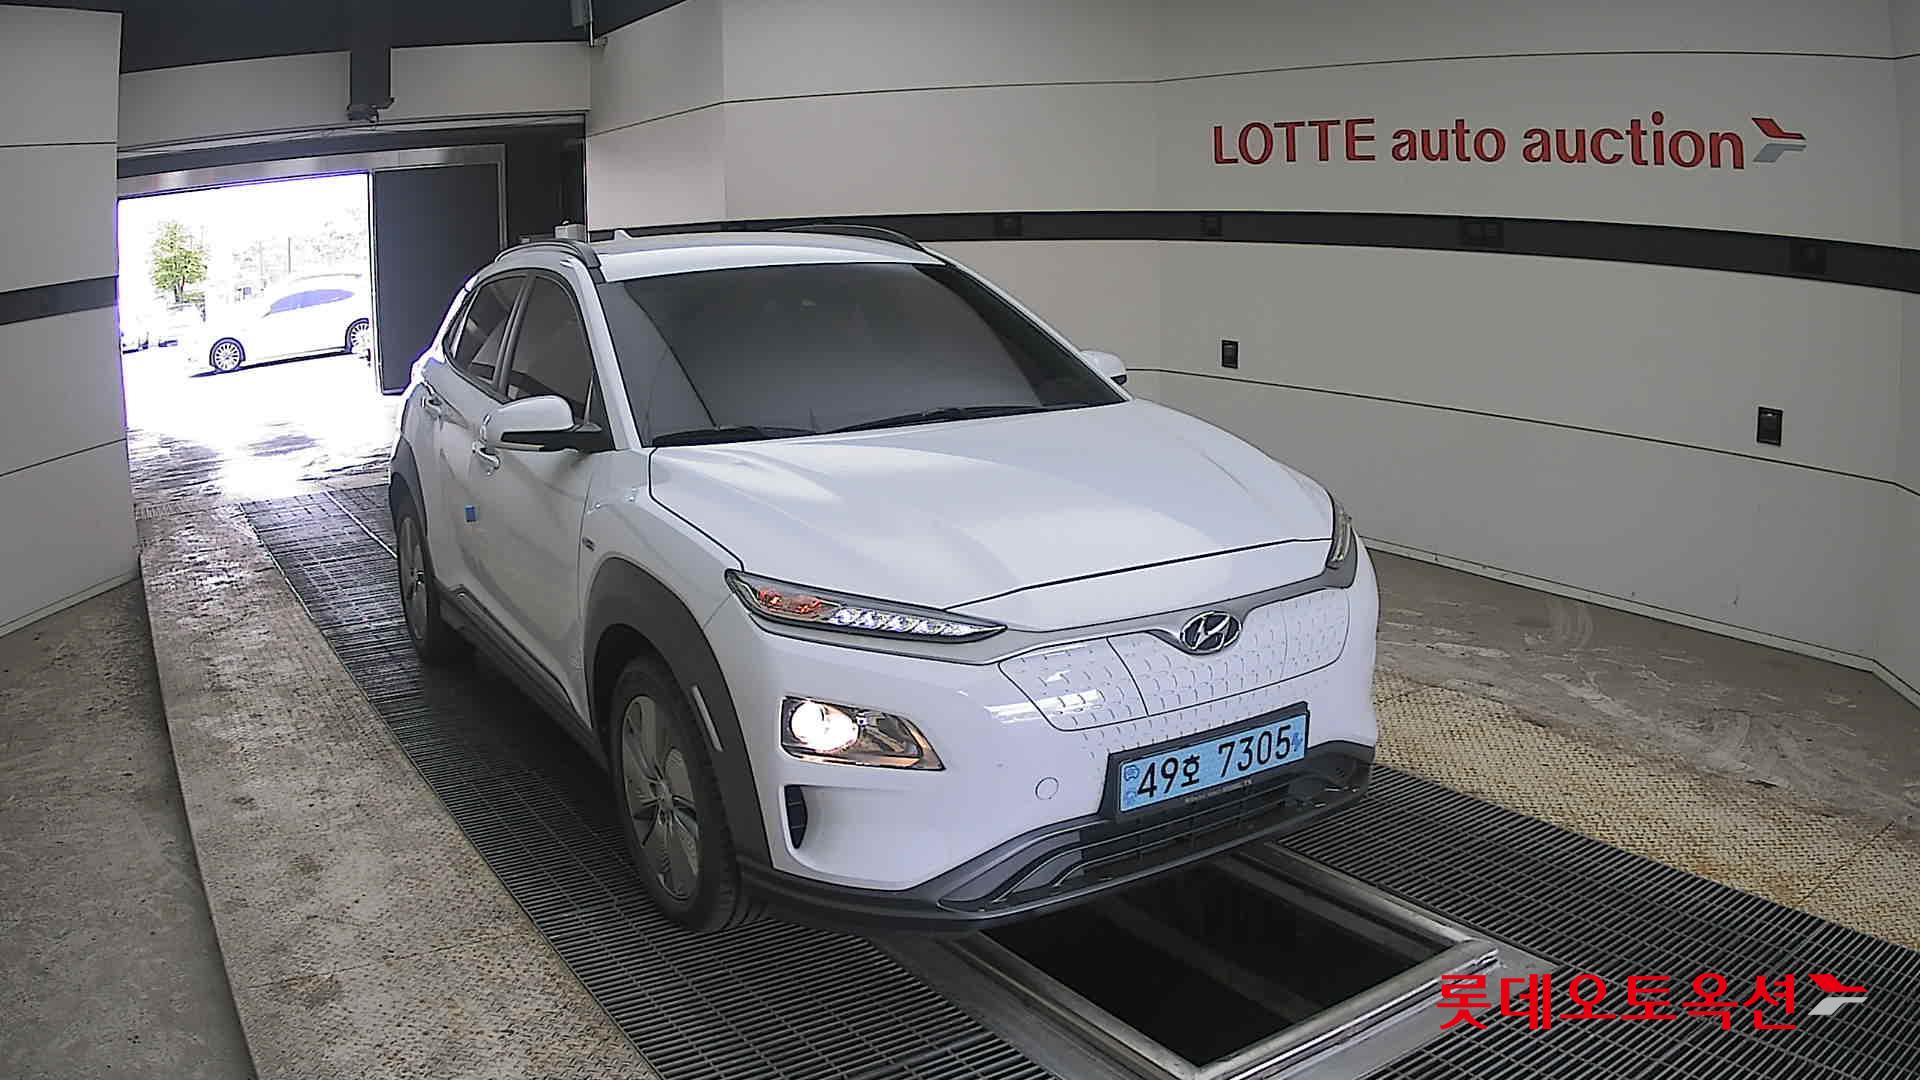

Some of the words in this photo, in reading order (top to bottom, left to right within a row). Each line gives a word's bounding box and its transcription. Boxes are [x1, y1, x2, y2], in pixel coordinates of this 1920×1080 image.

[1213, 118, 1376, 165] LOTTE
[1391, 119, 1506, 162] auto
[1522, 111, 1745, 169] auction
[1137, 754, 1200, 798] 49호
[1218, 725, 1292, 778] 7305
